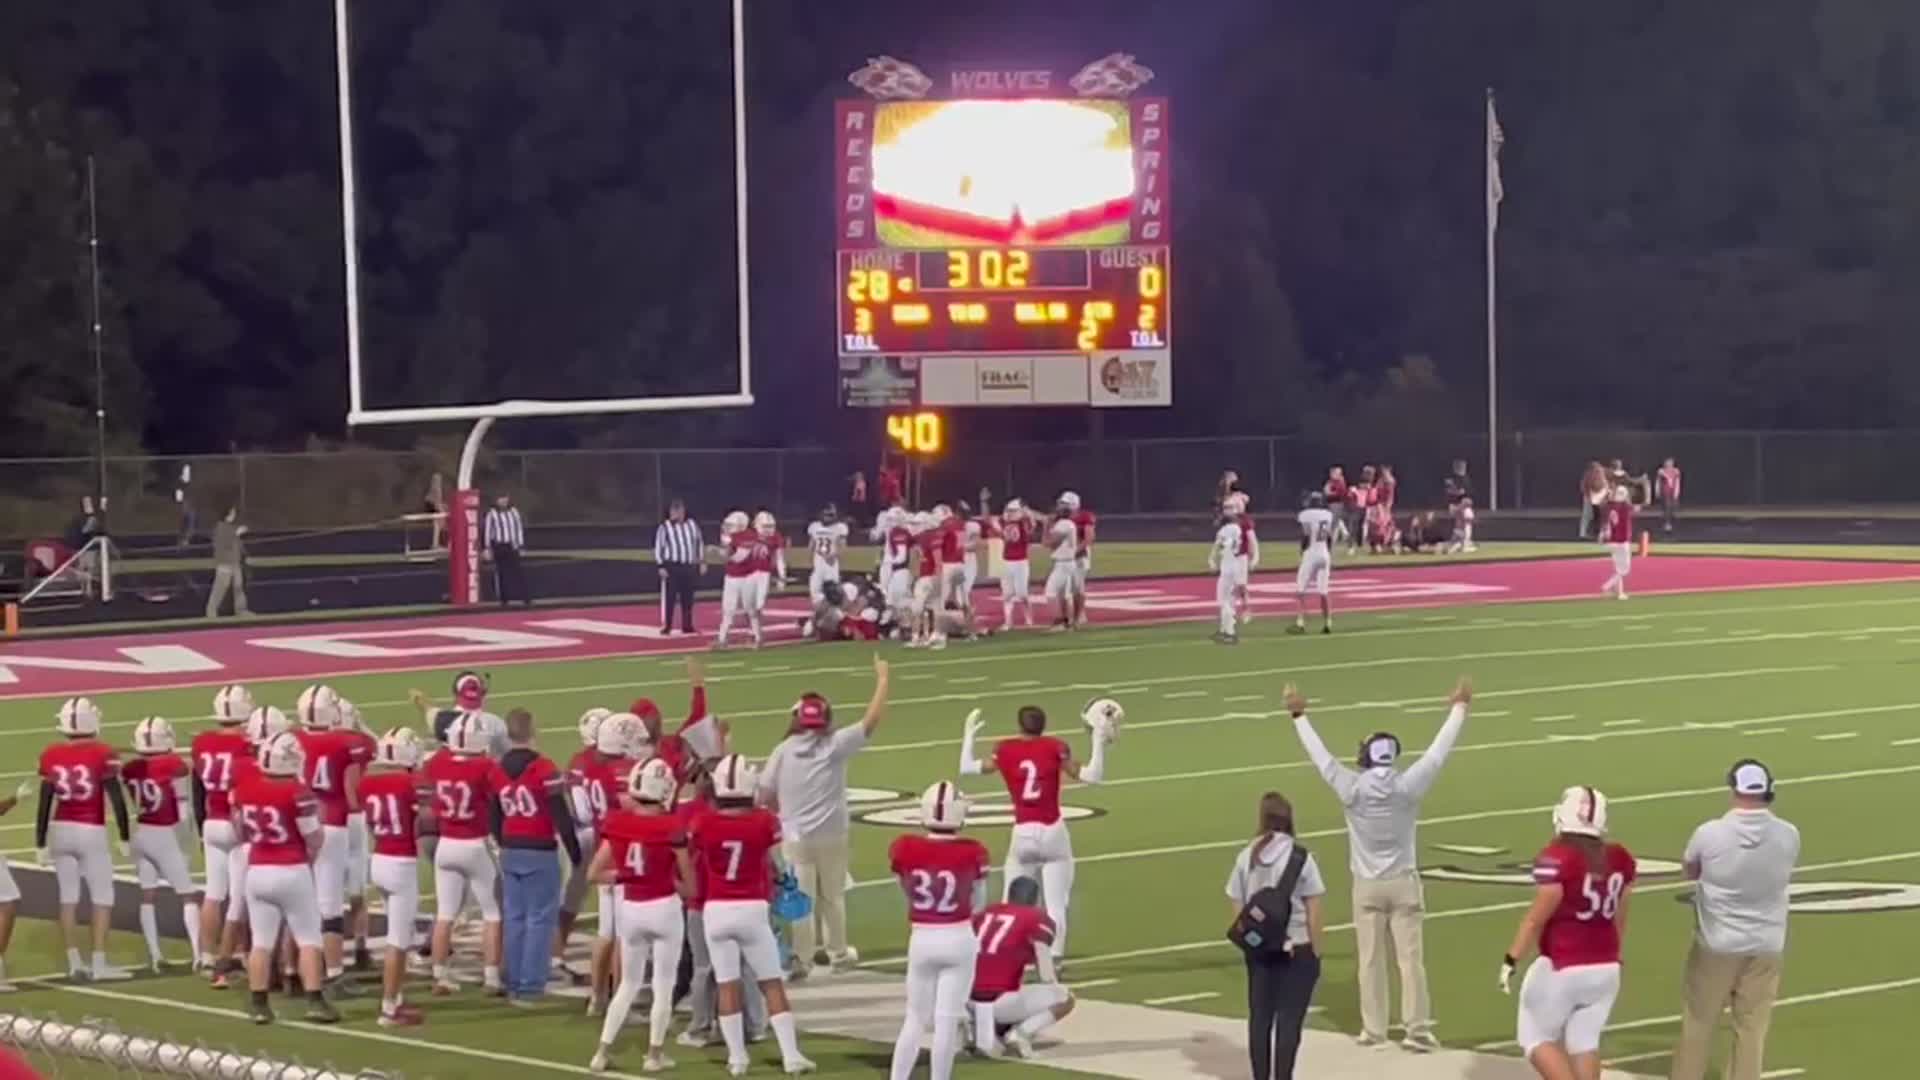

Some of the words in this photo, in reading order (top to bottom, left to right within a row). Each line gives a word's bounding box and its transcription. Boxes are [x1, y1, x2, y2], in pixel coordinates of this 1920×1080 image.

[951, 71, 1052, 90] WOLVES
[846, 111, 865, 239] REEDS
[1142, 103, 1161, 239] SPRING
[1100, 248, 1158, 268] GUEST
[848, 271, 890, 302] 28
[1140, 267, 1161, 299] 0
[887, 413, 940, 451] 40
[52, 764, 94, 801] 33
[200, 752, 233, 791] 27
[311, 755, 331, 790] 4
[1019, 759, 1042, 800] 2
[366, 793, 402, 835] 21
[436, 780, 475, 819] 52
[499, 784, 538, 817] 60
[242, 804, 289, 844] 53
[625, 842, 645, 876] 4
[722, 840, 743, 881] 7
[911, 869, 959, 913] 32
[1575, 872, 1624, 920] 58
